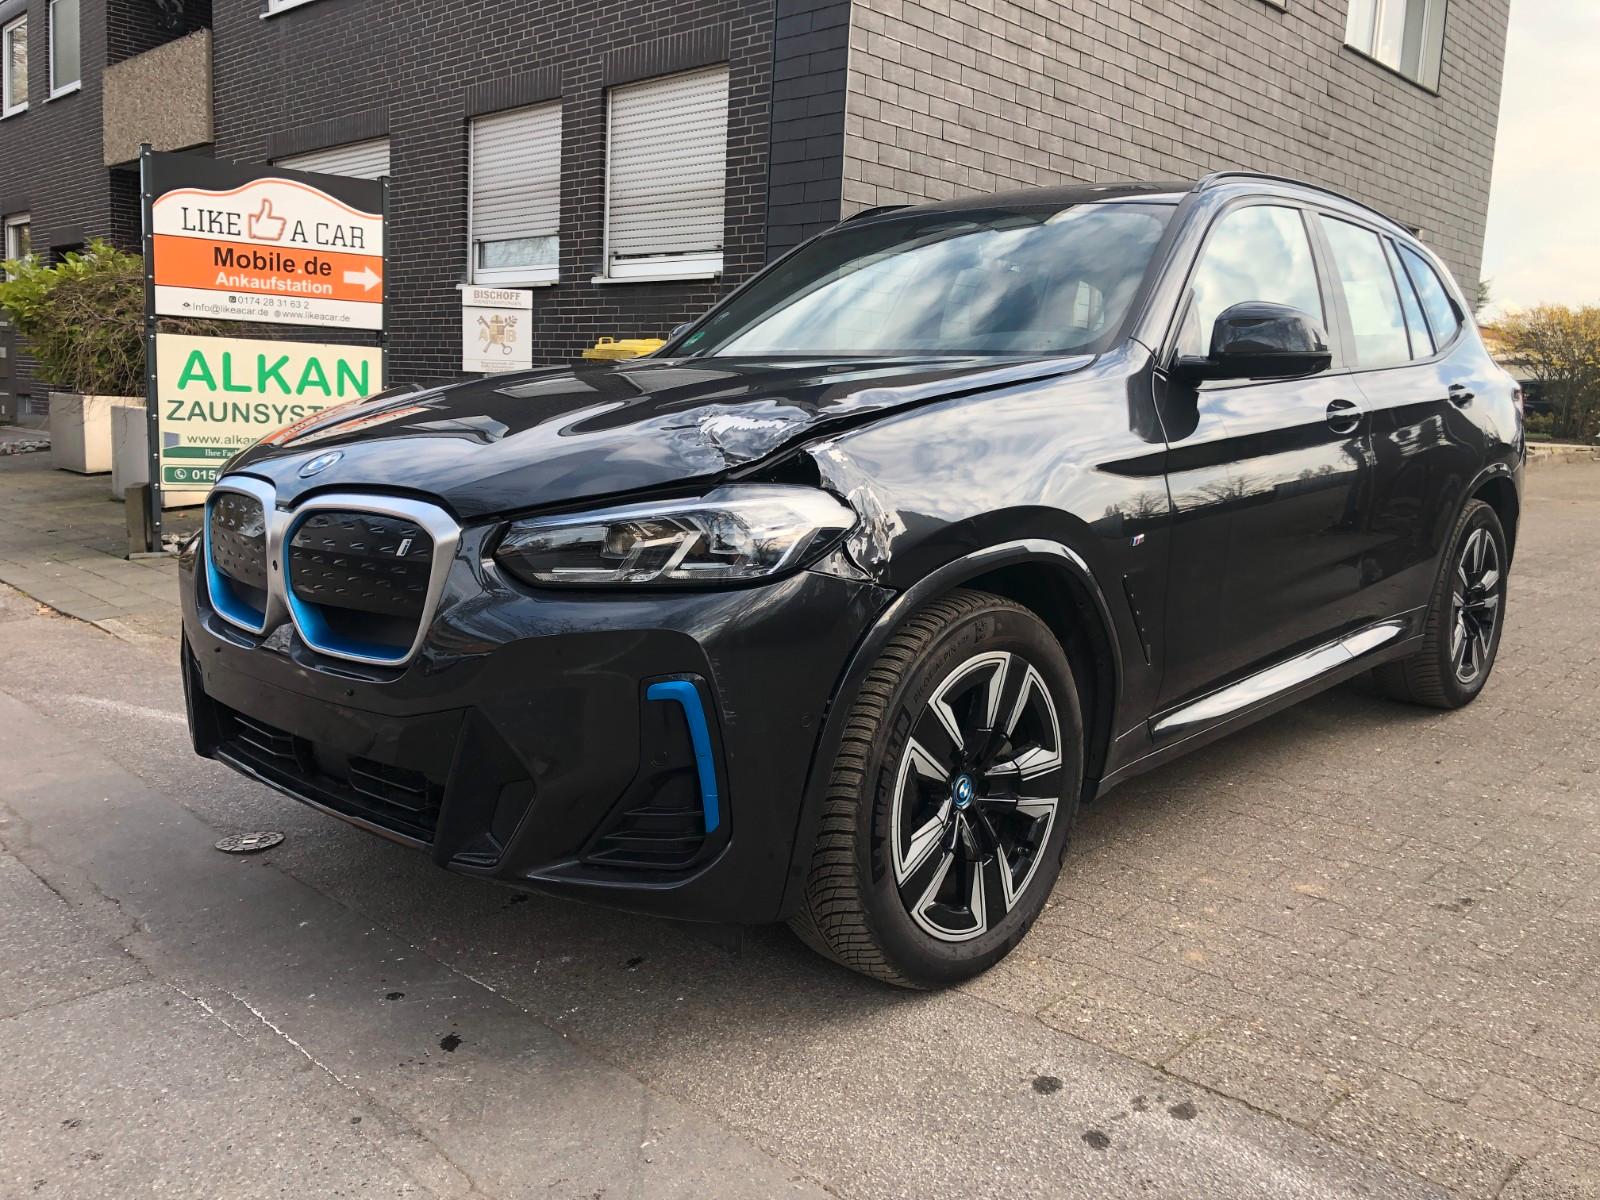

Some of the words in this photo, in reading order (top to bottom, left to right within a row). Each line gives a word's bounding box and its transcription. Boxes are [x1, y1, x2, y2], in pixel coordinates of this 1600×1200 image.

[181, 206, 242, 236] LIKE
[290, 220, 308, 243] A
[315, 222, 366, 249] CAR
[213, 247, 332, 276] Mobile.de
[215, 271, 333, 295] Ankaufstation
[473, 290, 521, 300] BISCHOFF
[237, 296, 260, 306] 0174
[263, 296, 274, 307] 28
[276, 298, 288, 307] 31
[289, 299, 301, 309] 63
[282, 311, 351, 323] www.likeacar.de
[177, 349, 369, 397] ALKAN
[166, 399, 329, 424] ZAUNSYST
